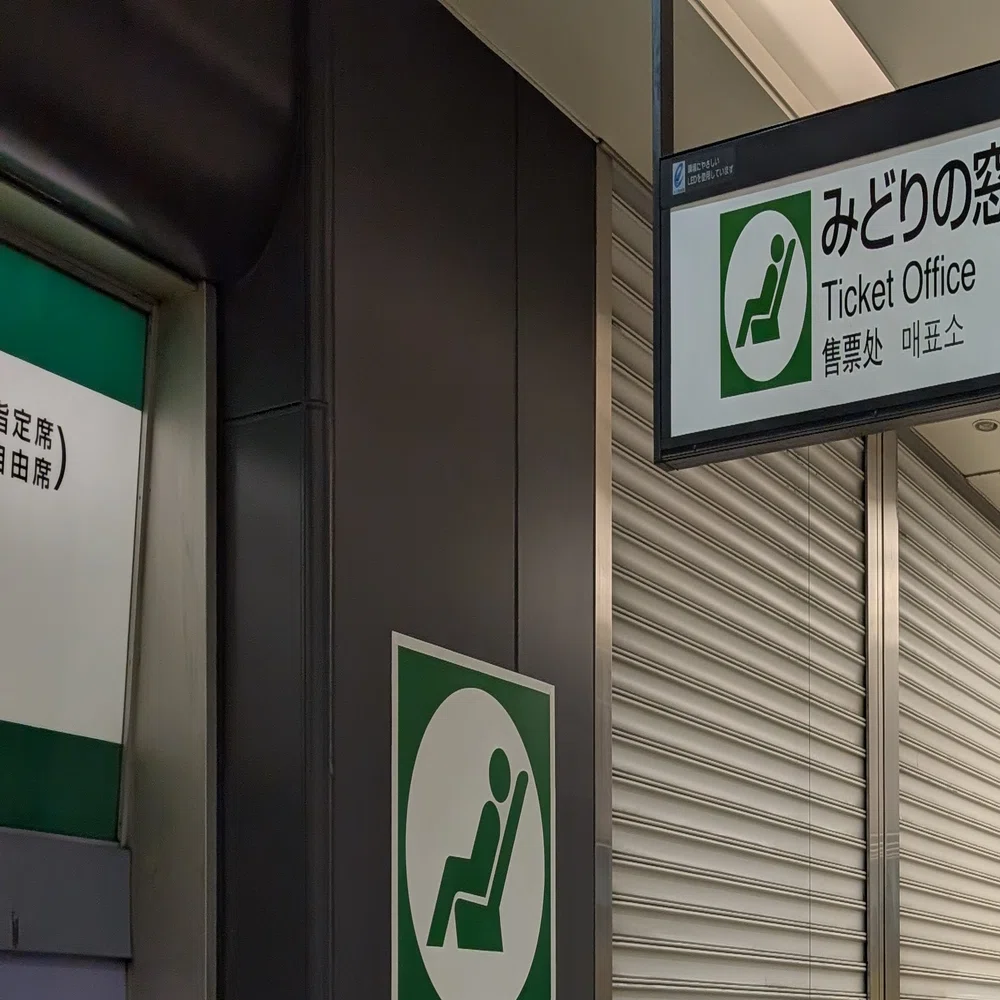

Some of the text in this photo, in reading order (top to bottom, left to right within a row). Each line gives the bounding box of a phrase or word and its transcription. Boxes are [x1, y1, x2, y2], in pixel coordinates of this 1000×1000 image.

[821, 255, 976, 321] Ticket Office
[822, 327, 883, 377] 售票处
[902, 313, 964, 358] 매표소
